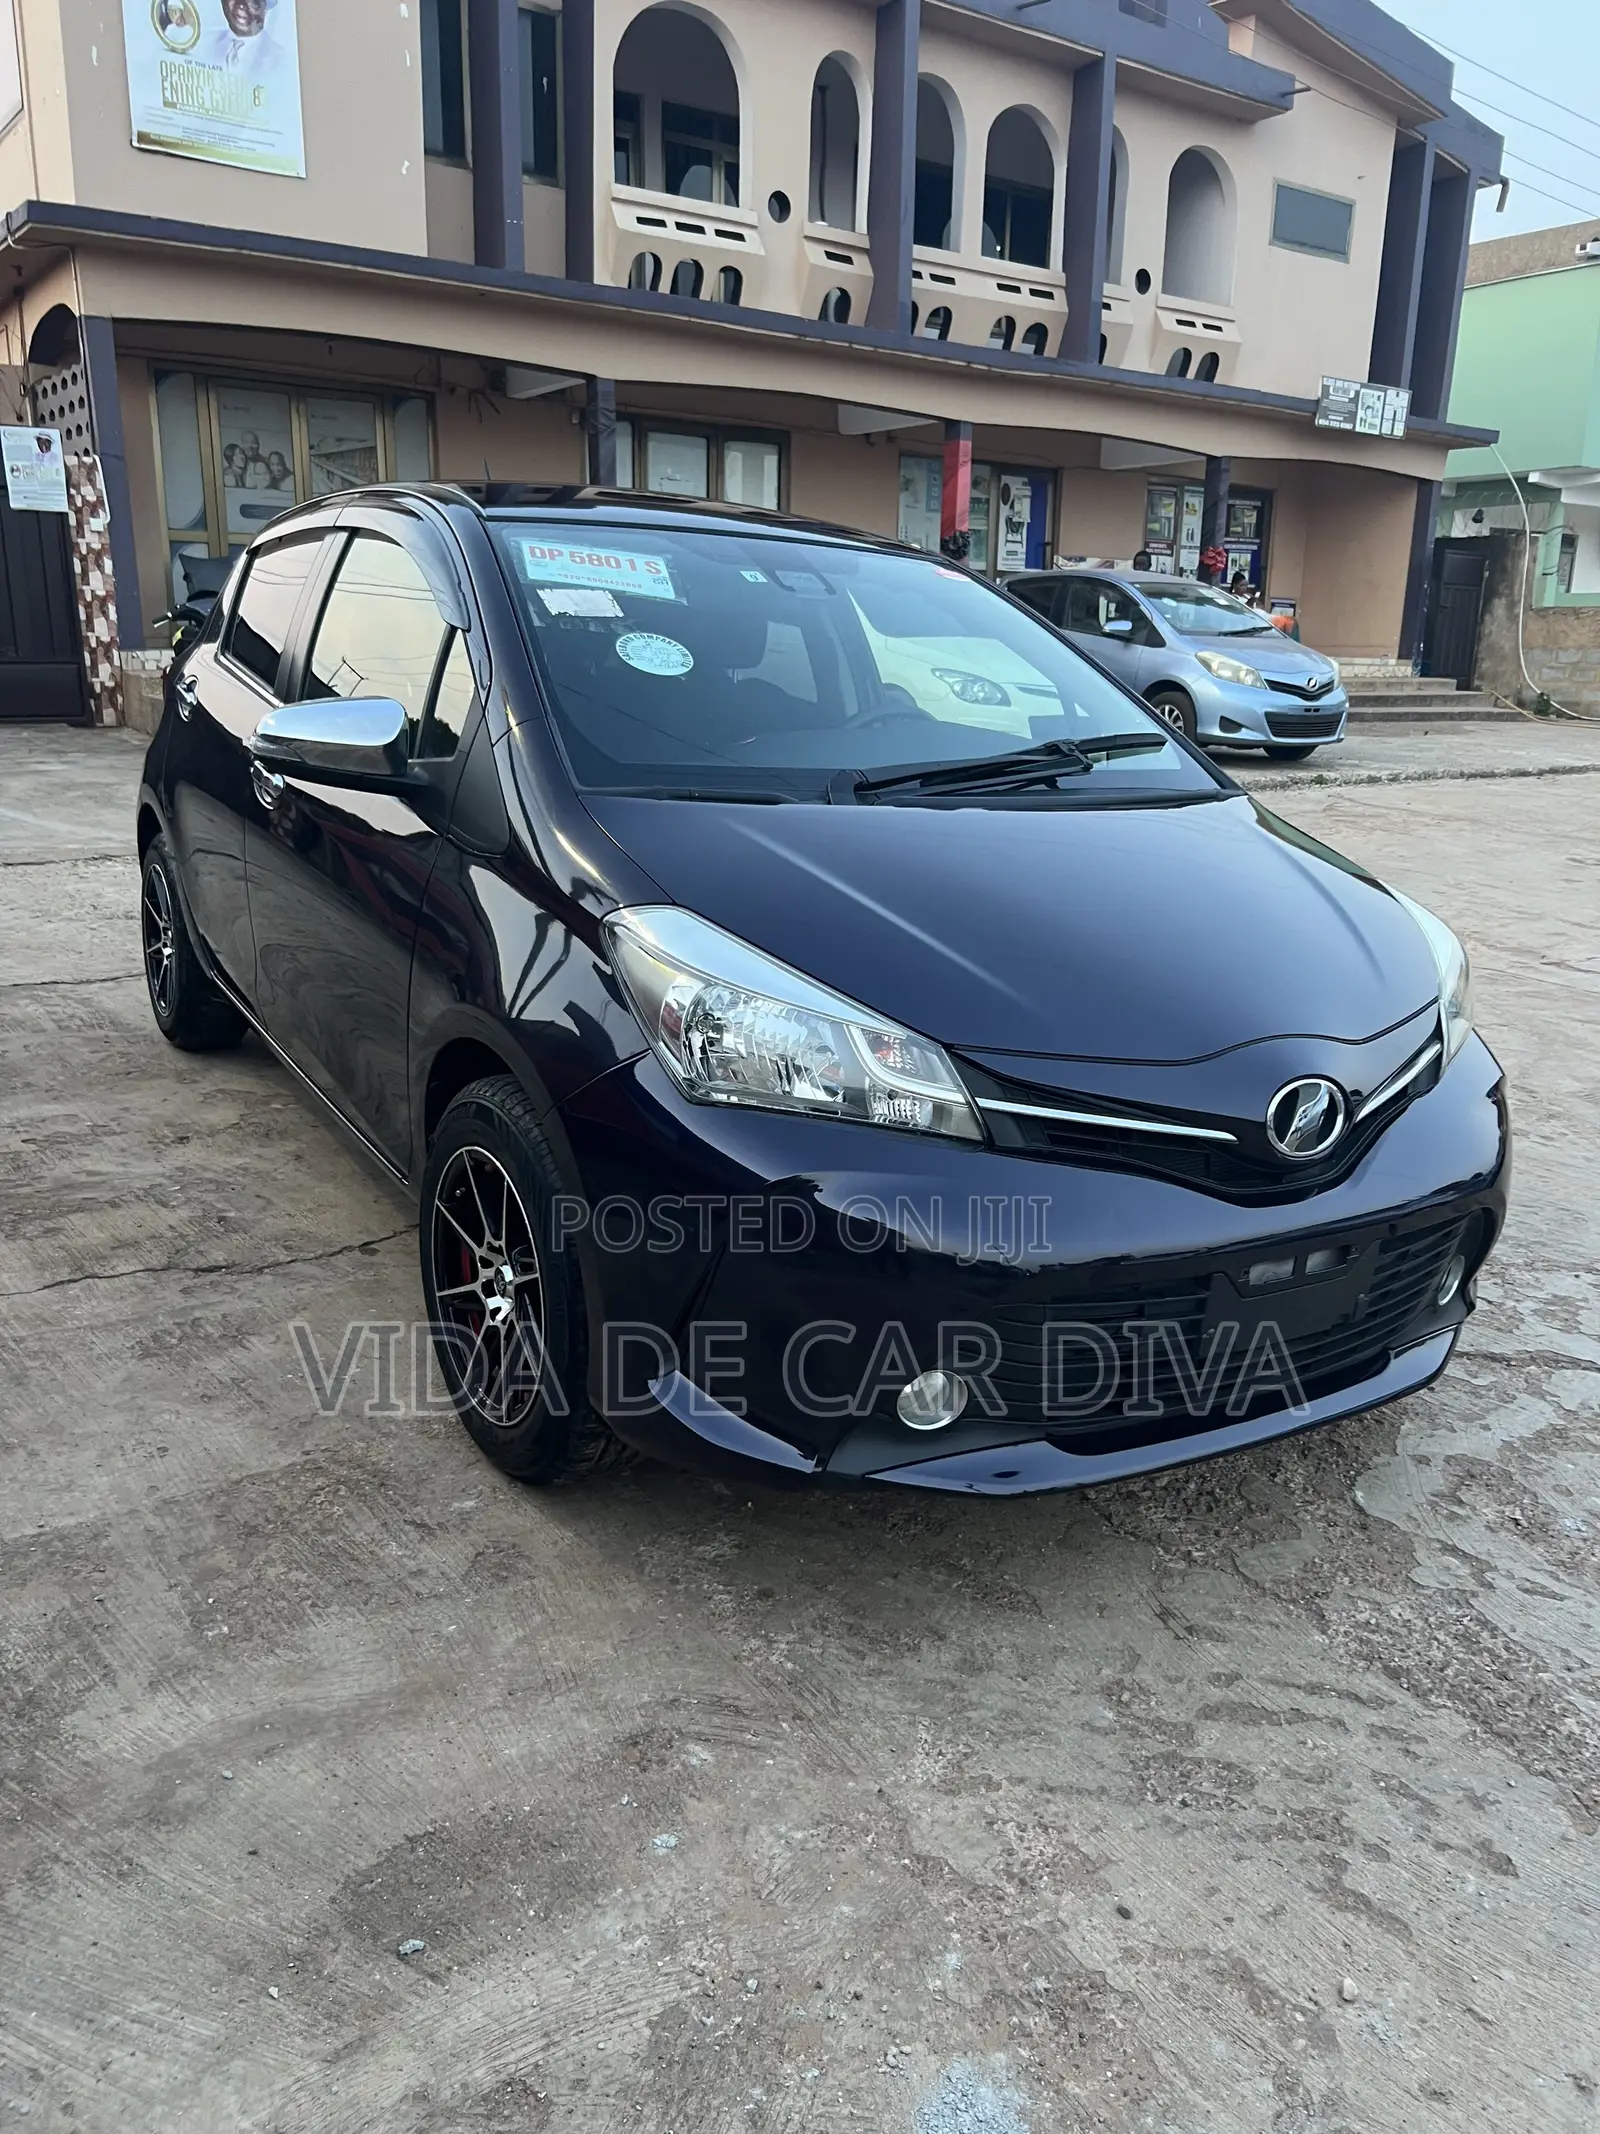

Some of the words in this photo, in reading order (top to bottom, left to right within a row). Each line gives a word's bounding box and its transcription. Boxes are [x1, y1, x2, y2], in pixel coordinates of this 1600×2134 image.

[208, 63, 223, 71] LATE
[528, 545, 564, 561] DP
[568, 550, 637, 572] 5801
[644, 560, 662, 575] S
[633, 634, 679, 648] COMPANY
